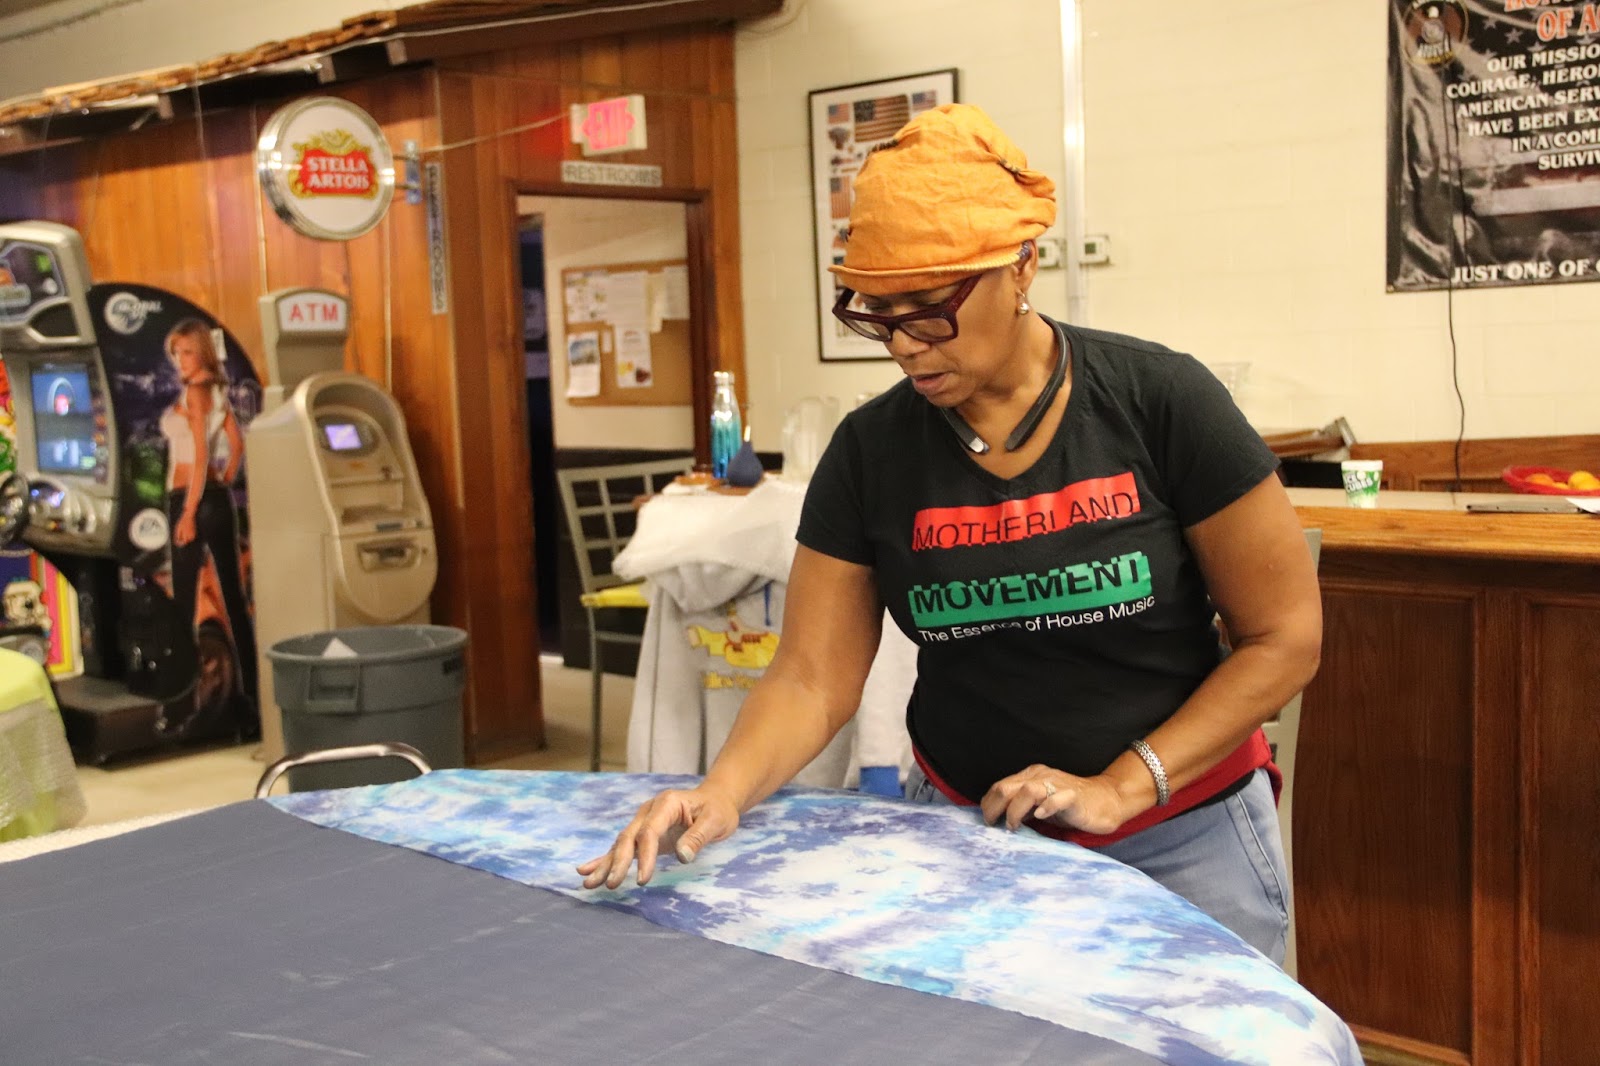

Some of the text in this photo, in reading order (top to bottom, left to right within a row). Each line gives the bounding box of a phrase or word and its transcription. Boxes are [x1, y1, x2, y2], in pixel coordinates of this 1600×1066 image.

[1536, 3, 1600, 42] OF A
[1487, 55, 1526, 73] OUR
[1446, 62, 1600, 98] COURAGE, HERO
[1456, 92, 1549, 118] AMERICAN
[1467, 118, 1514, 137] HAVE
[1518, 110, 1568, 131] BEEN
[1512, 127, 1600, 152] IN A COM
[306, 156, 369, 173] STELLA
[564, 163, 661, 185] RESTROOMS
[308, 174, 370, 190] ARTOIS
[1451, 264, 1500, 284] JUST
[1505, 260, 1553, 280] ONE
[1558, 258, 1590, 277] OF
[289, 302, 339, 323] ATM
[913, 556, 1142, 614] MOVEMENT
[918, 594, 1155, 642] The Essence of House Music
